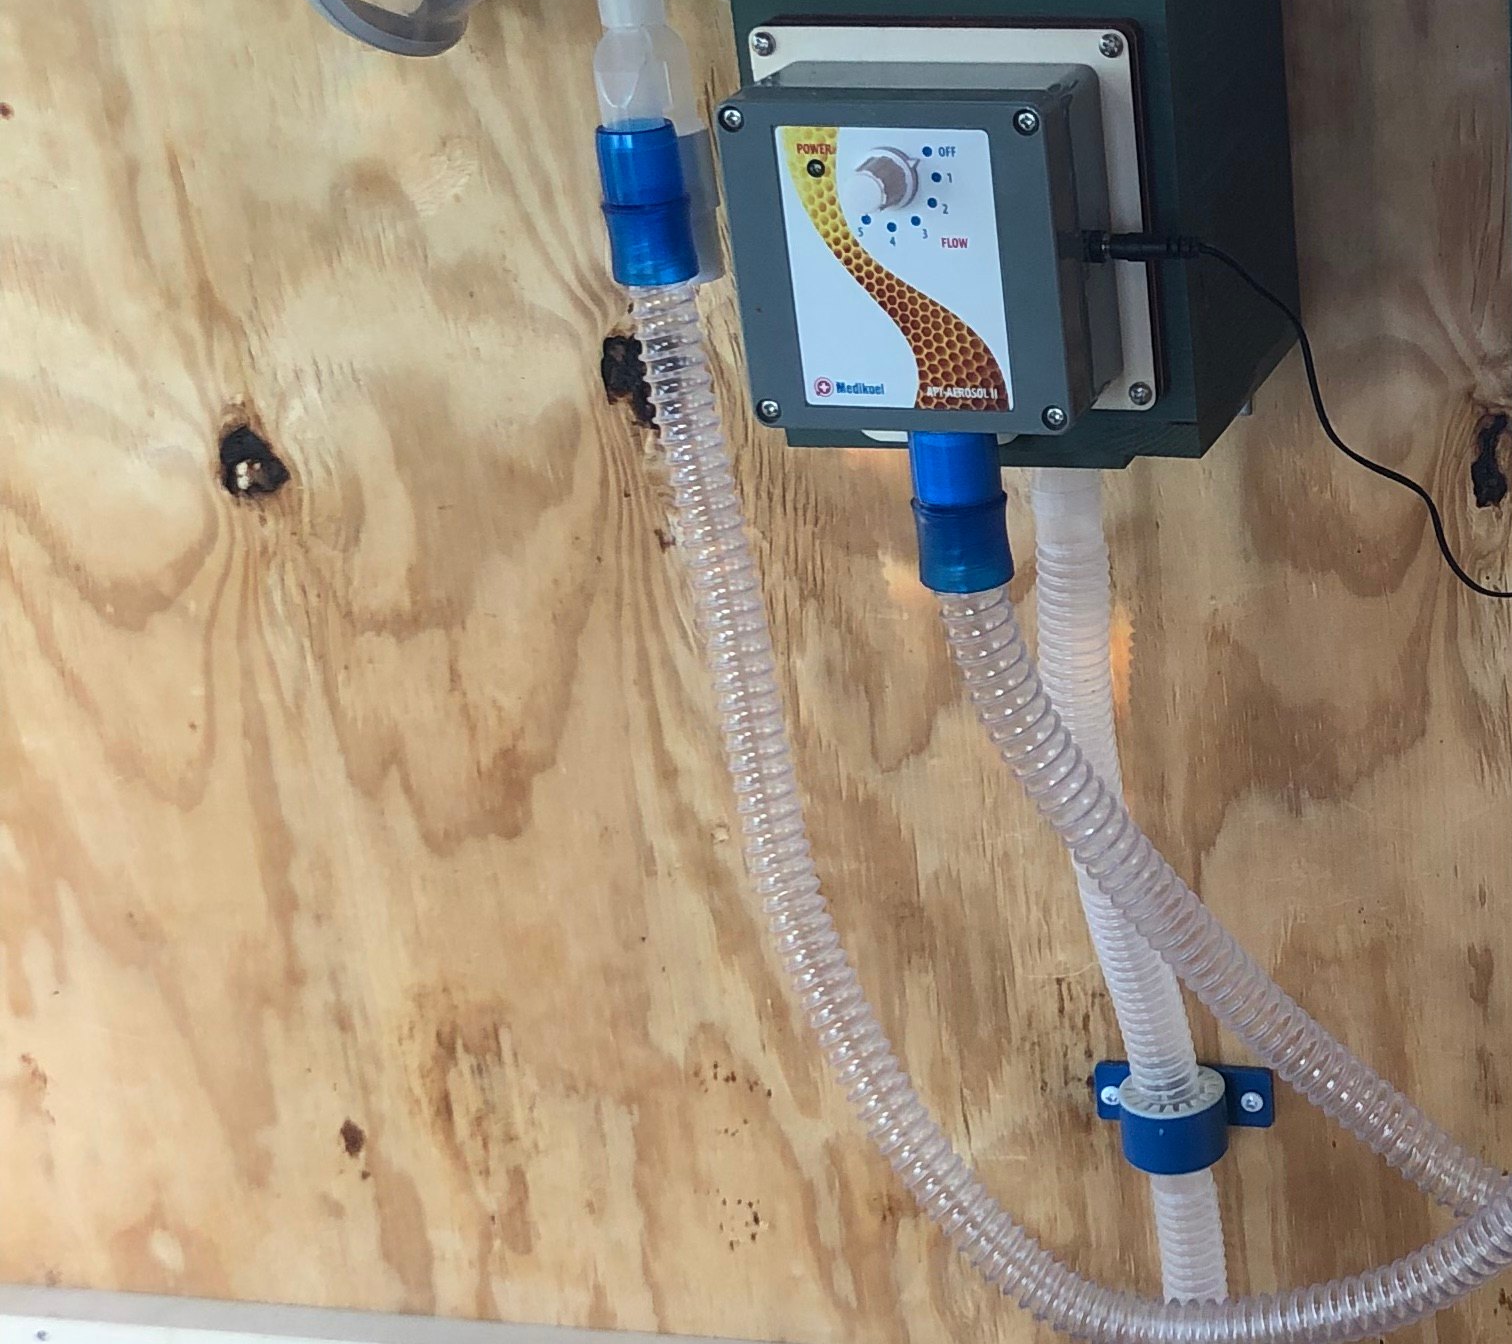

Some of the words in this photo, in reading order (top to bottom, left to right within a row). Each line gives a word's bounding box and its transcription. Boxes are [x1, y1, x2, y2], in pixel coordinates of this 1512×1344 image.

[796, 143, 832, 155] POWER
[938, 146, 956, 158] OFF
[946, 172, 953, 183] 1
[941, 203, 949, 214] 2
[857, 226, 864, 237] 5
[922, 228, 928, 239] 3
[889, 236, 896, 247] 4
[941, 237, 969, 249] FLOW
[836, 381, 885, 396] Medikoel
